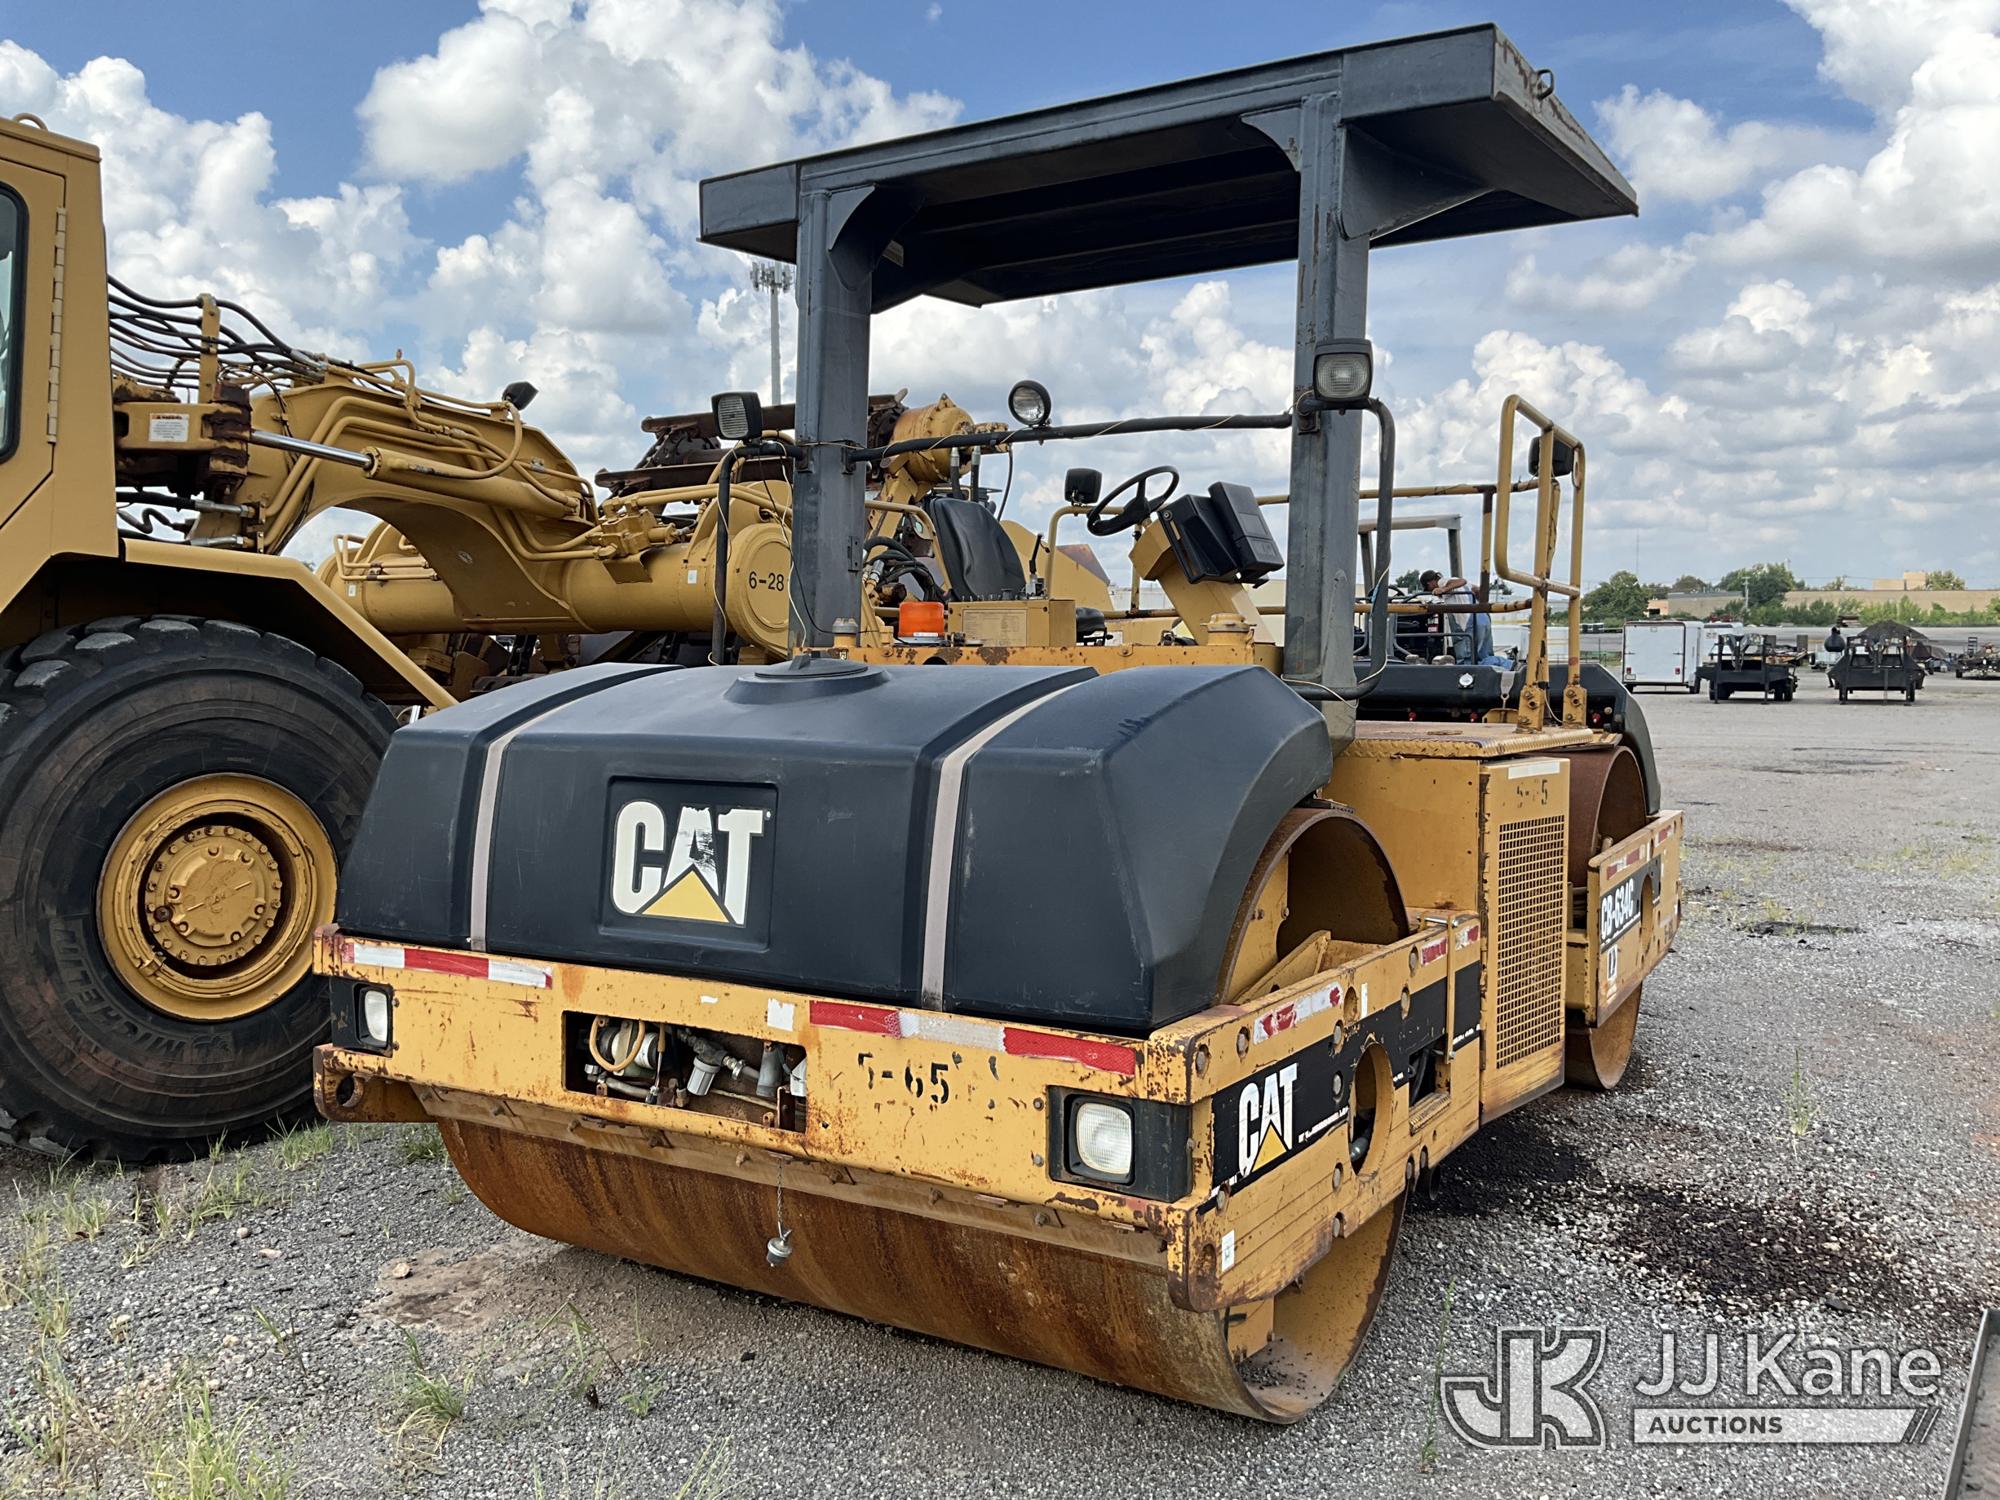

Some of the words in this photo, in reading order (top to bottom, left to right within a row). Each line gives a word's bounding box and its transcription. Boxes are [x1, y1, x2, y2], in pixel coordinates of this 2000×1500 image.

[749, 571, 785, 592] 6-28
[612, 800, 765, 927] CAT
[1601, 876, 1634, 940] CB-634C
[1238, 1062, 1298, 1178] CAT
